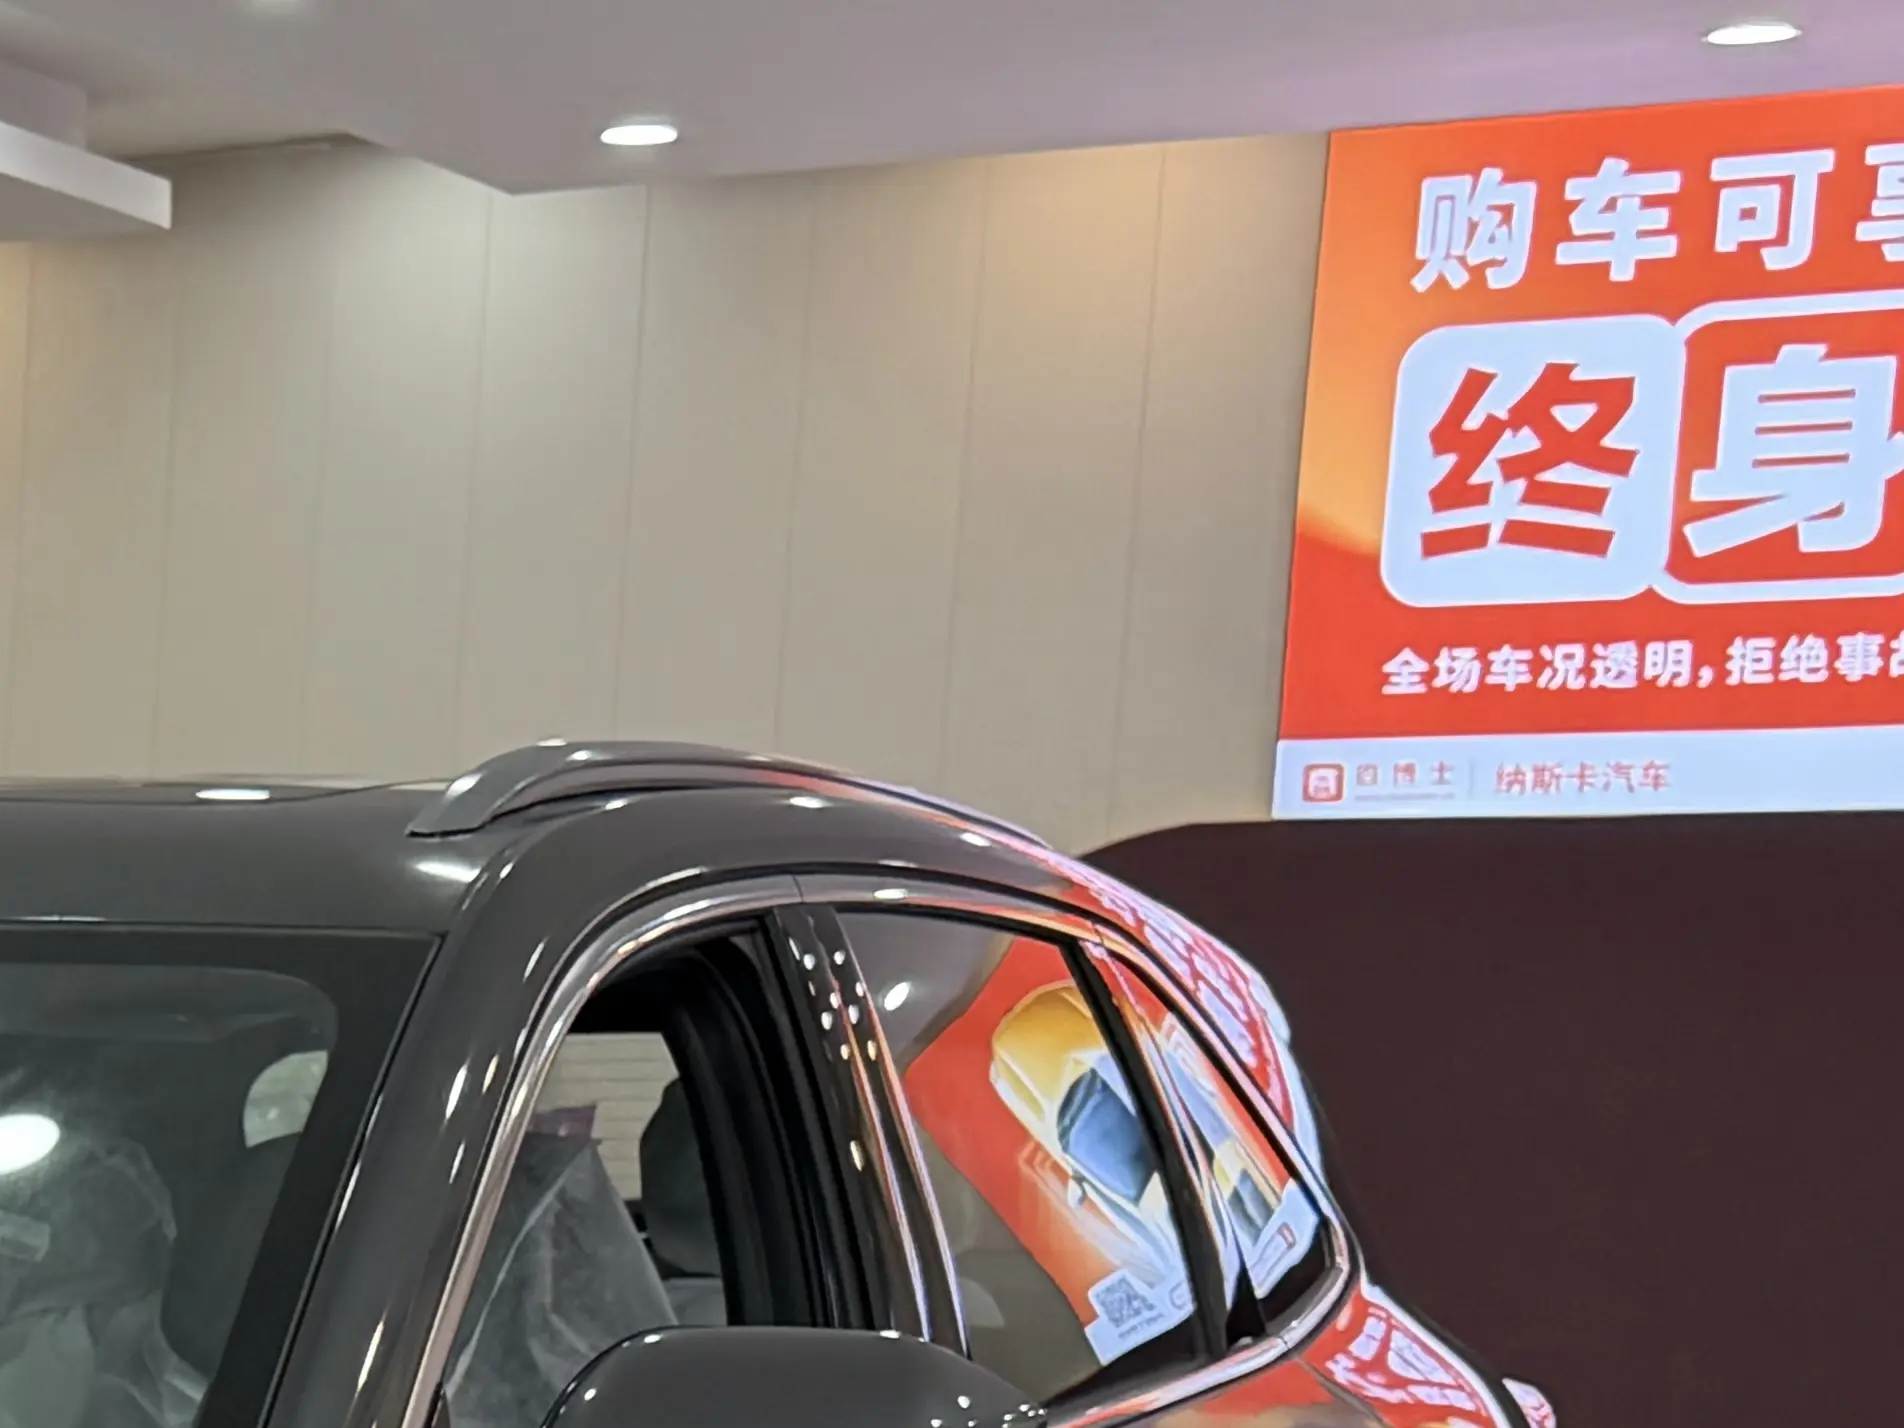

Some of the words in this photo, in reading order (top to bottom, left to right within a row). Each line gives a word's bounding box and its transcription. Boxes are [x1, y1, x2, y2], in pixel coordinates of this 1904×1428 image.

[1420, 342, 1904, 560] 终身
[1495, 759, 1671, 797] 纳斯卡汽车
